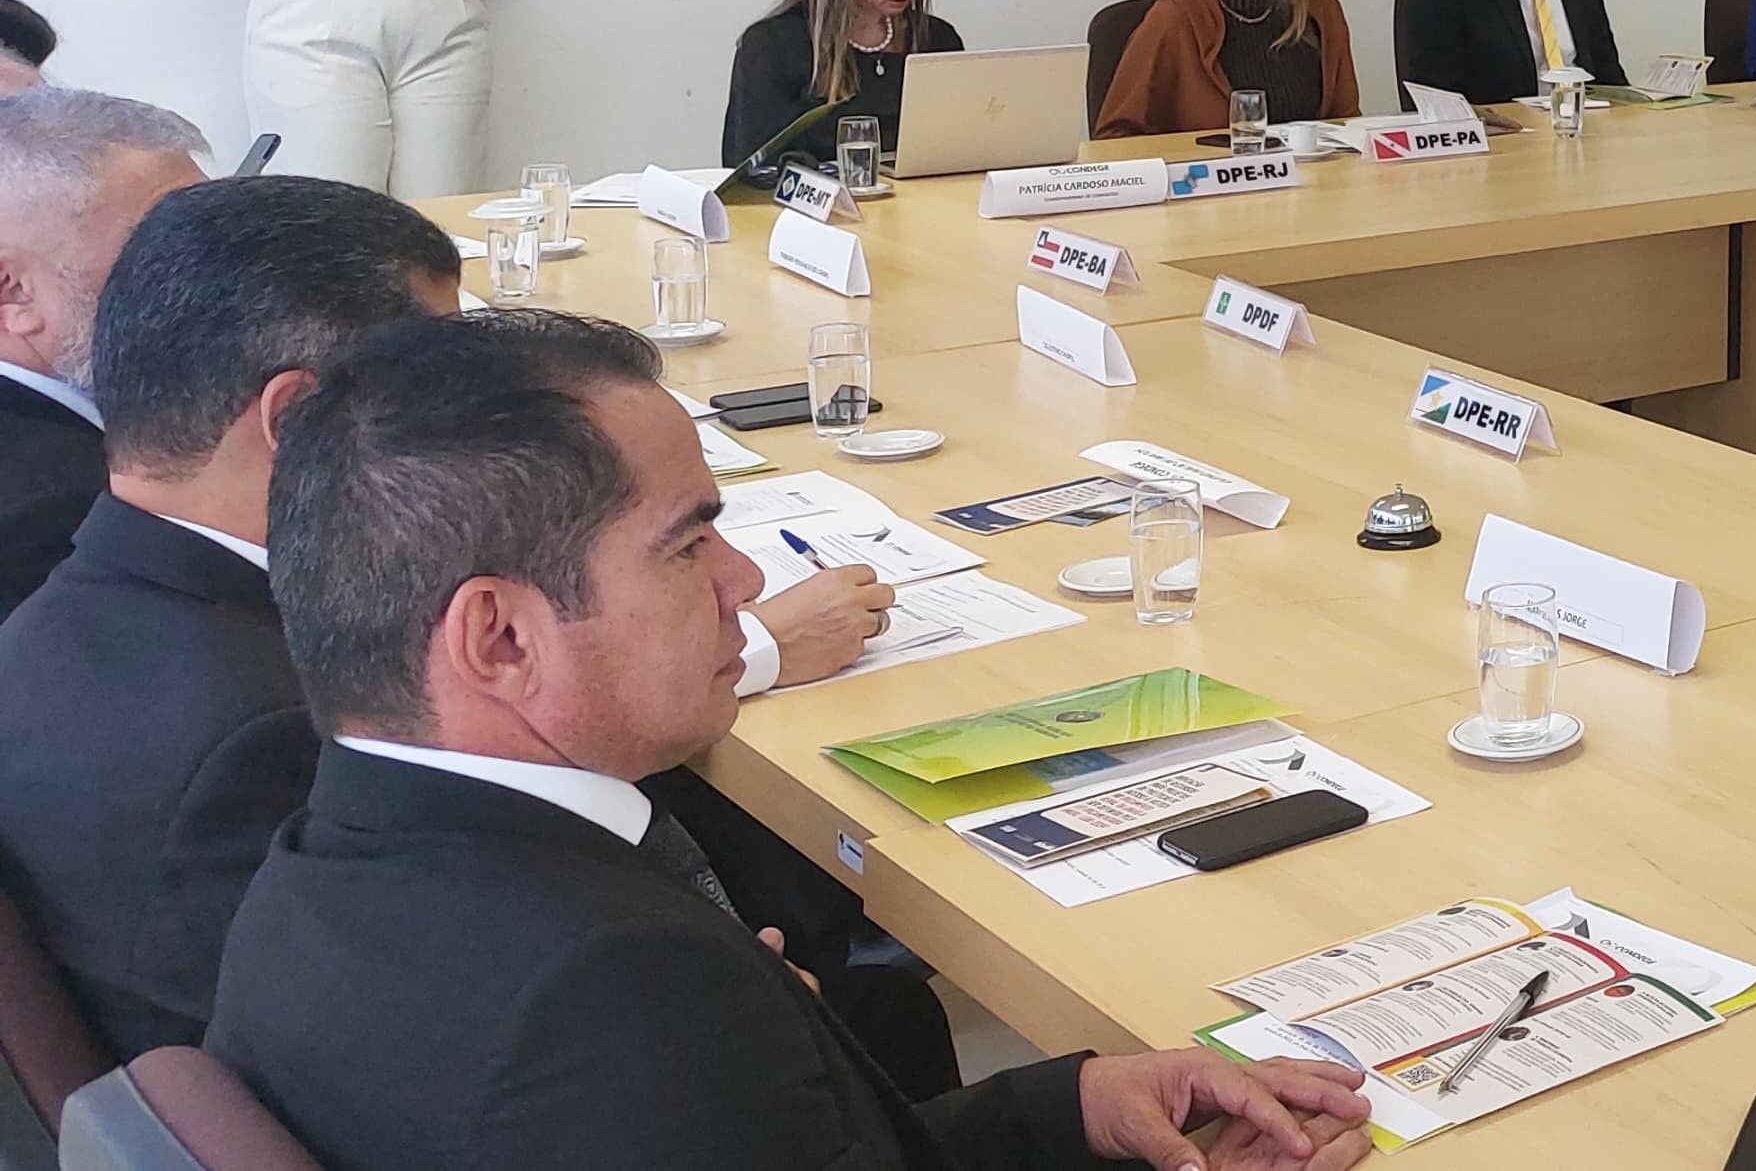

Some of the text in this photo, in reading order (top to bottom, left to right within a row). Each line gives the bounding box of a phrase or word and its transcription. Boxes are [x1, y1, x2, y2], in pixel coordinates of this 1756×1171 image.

[1414, 130, 1481, 150] DPE-PA
[1063, 179, 1109, 191] CARDOSO
[1110, 176, 1145, 188] MACIEL
[1216, 162, 1289, 185] DPE-RJ
[1059, 245, 1108, 278] DPE-BA
[1242, 302, 1280, 333] DPDF
[1453, 395, 1523, 440] DPE-RR
[1562, 611, 1588, 630] JORGE
